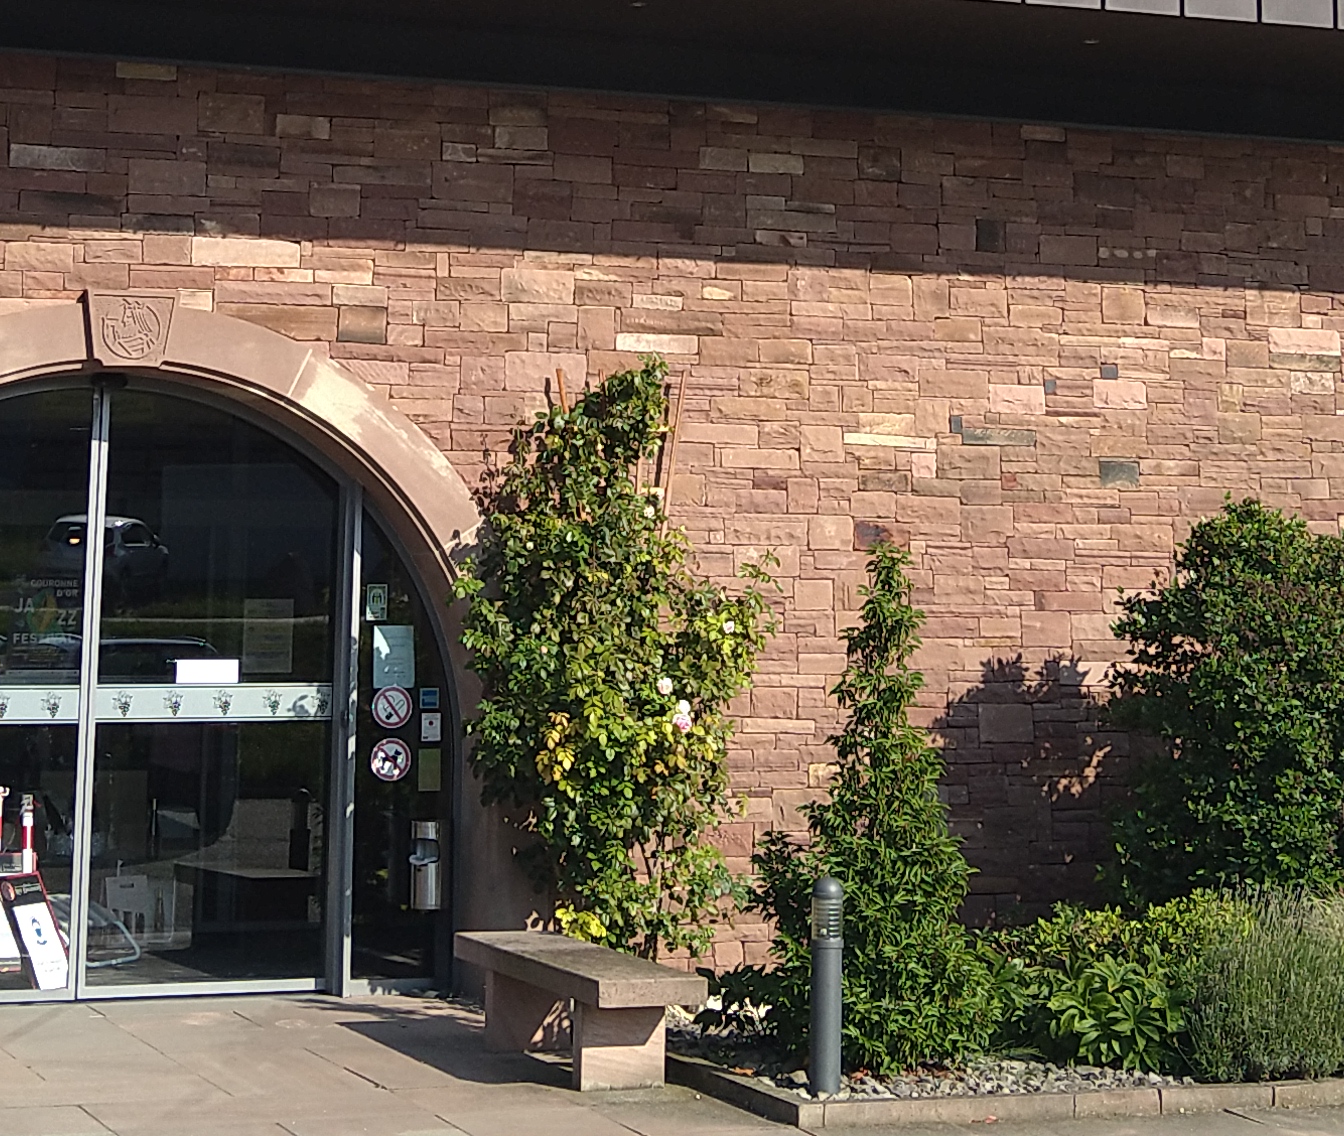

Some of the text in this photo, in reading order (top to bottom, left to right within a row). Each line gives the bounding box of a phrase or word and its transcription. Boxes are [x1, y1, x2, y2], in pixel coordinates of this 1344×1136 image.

[31, 579, 78, 588] COURONNE
[57, 589, 78, 597] D'OR
[13, 633, 76, 644] FESL
